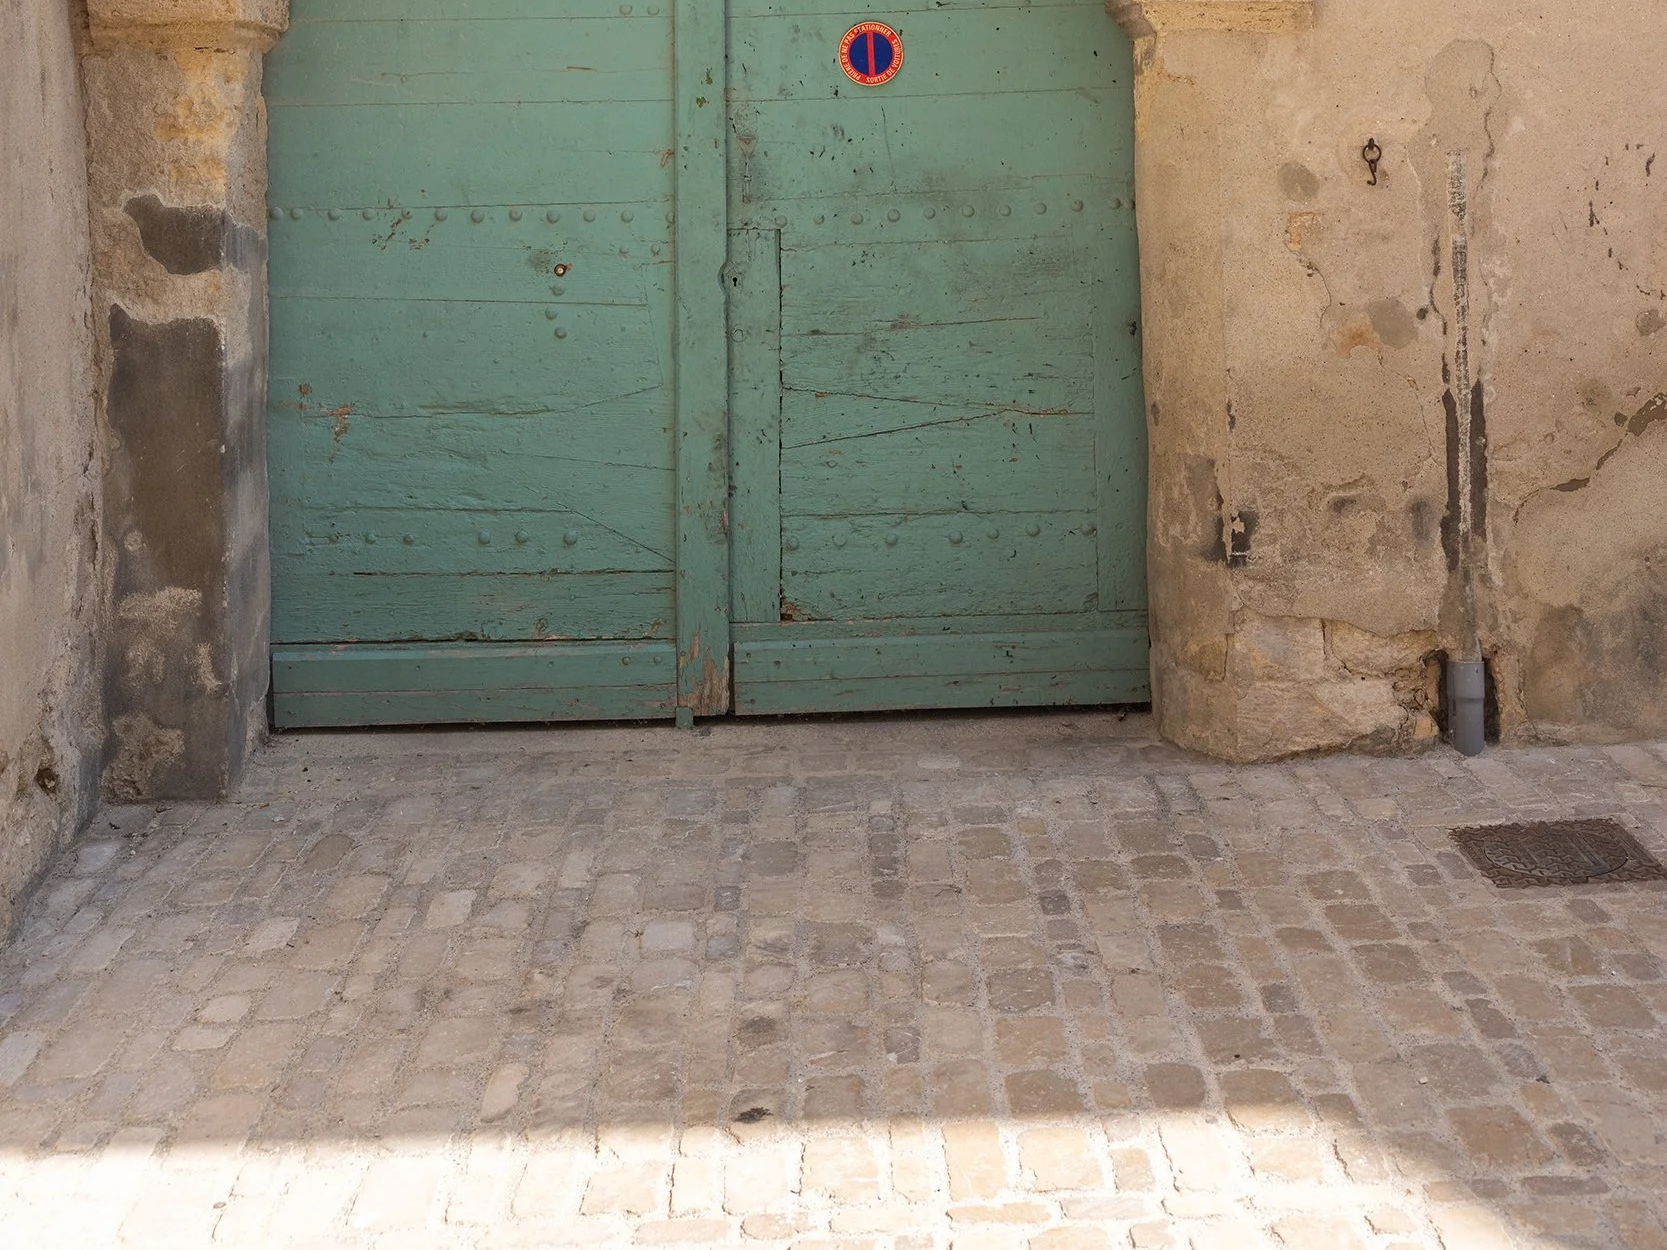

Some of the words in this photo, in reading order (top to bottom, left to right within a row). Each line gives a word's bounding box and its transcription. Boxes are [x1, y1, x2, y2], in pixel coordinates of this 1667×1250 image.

[854, 24, 891, 36] STATIONNER
[844, 32, 855, 44] PAS
[841, 44, 848, 53] NE
[841, 54, 848, 62] DE
[866, 74, 887, 83] SORTIE
[887, 68, 895, 76] DE
[892, 38, 902, 68] VOITURES
